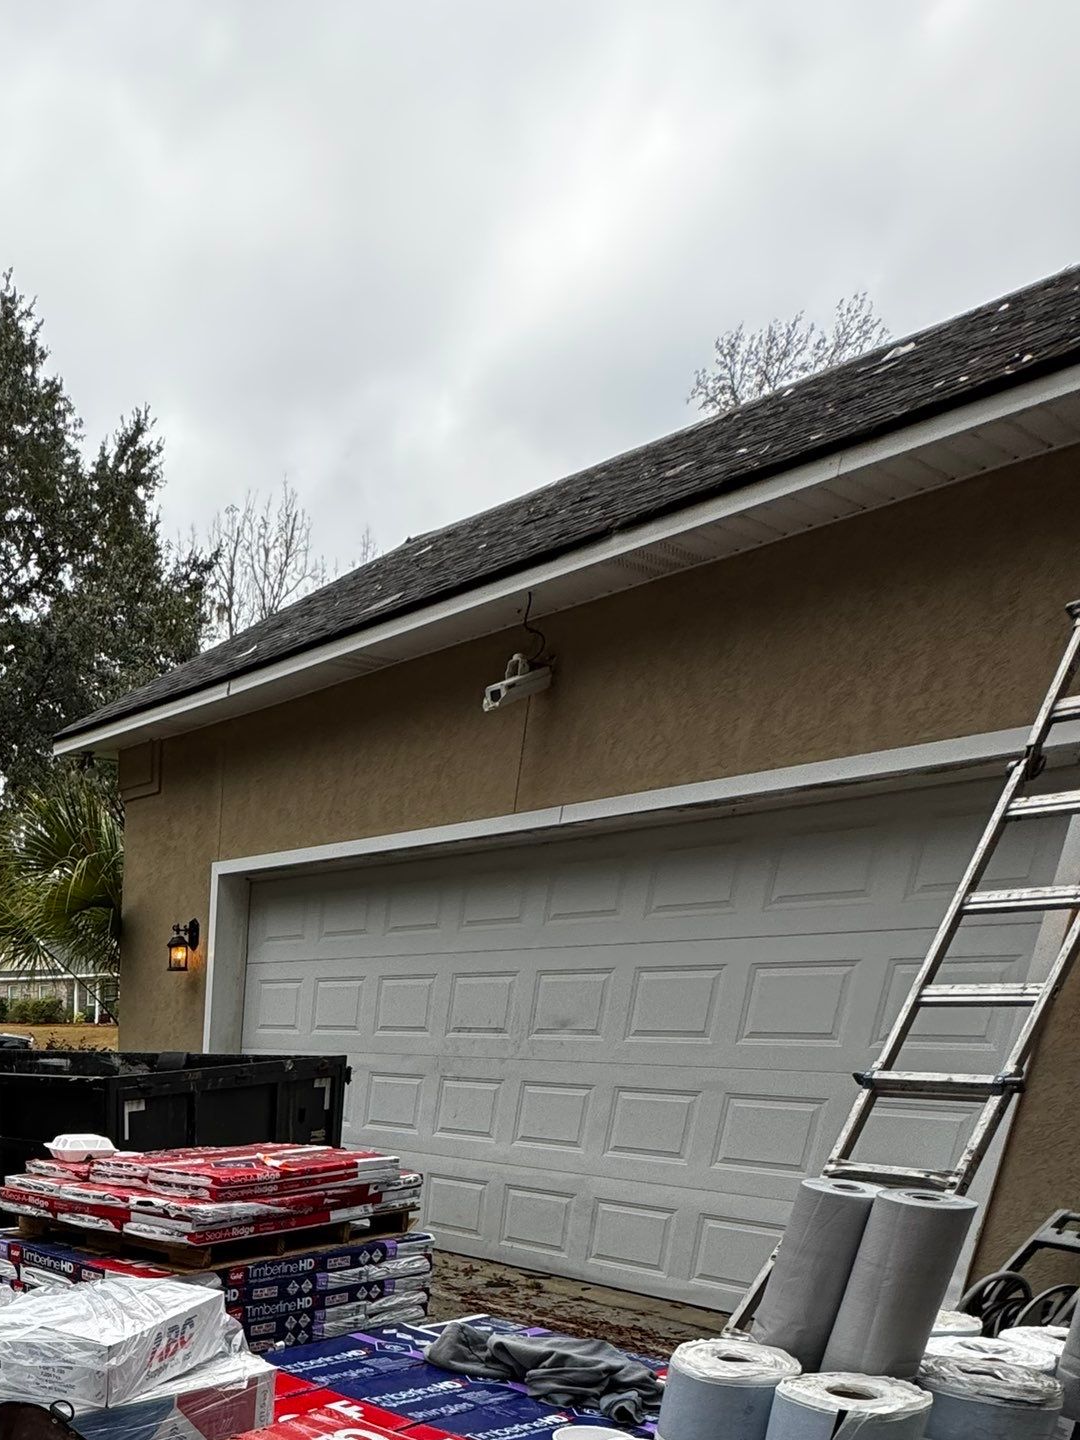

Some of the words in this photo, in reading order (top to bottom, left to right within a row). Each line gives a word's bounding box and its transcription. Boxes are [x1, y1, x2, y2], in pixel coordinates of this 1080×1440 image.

[23, 1247, 61, 1270] Timberline
[247, 1261, 298, 1280] Timberline
[245, 1299, 297, 1318] Timberline
